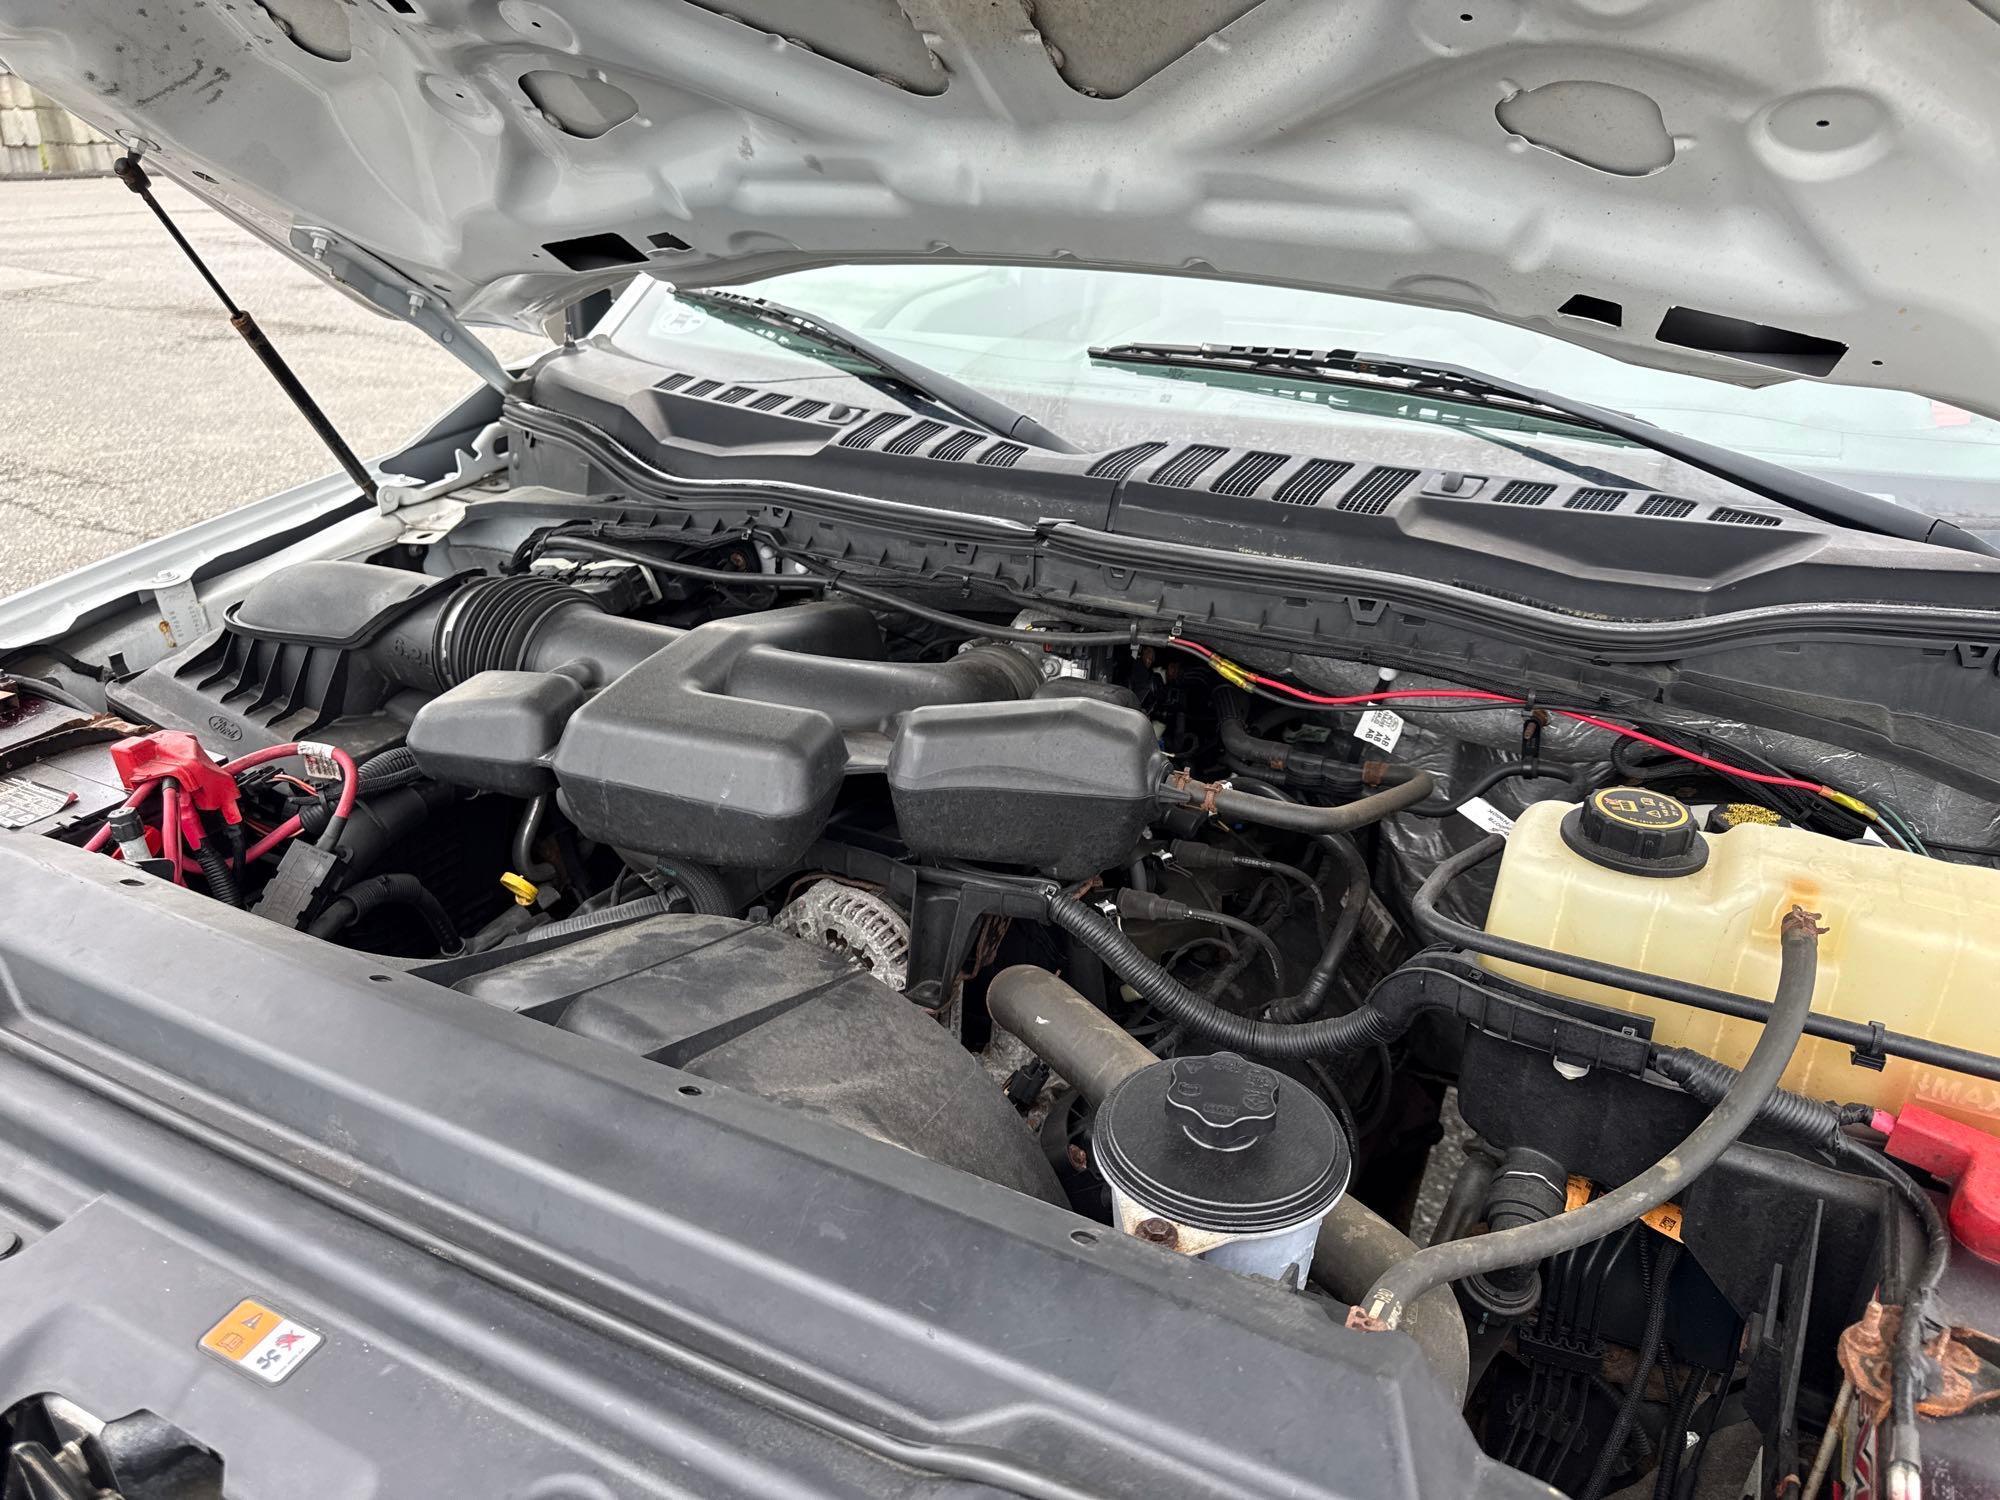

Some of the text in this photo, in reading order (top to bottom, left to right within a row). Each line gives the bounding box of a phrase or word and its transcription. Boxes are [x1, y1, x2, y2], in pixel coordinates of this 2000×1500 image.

[210, 717, 241, 740] Ford
[1365, 728, 1375, 739] AB
[1373, 731, 1383, 742] AB
[1381, 734, 1391, 747] AB
